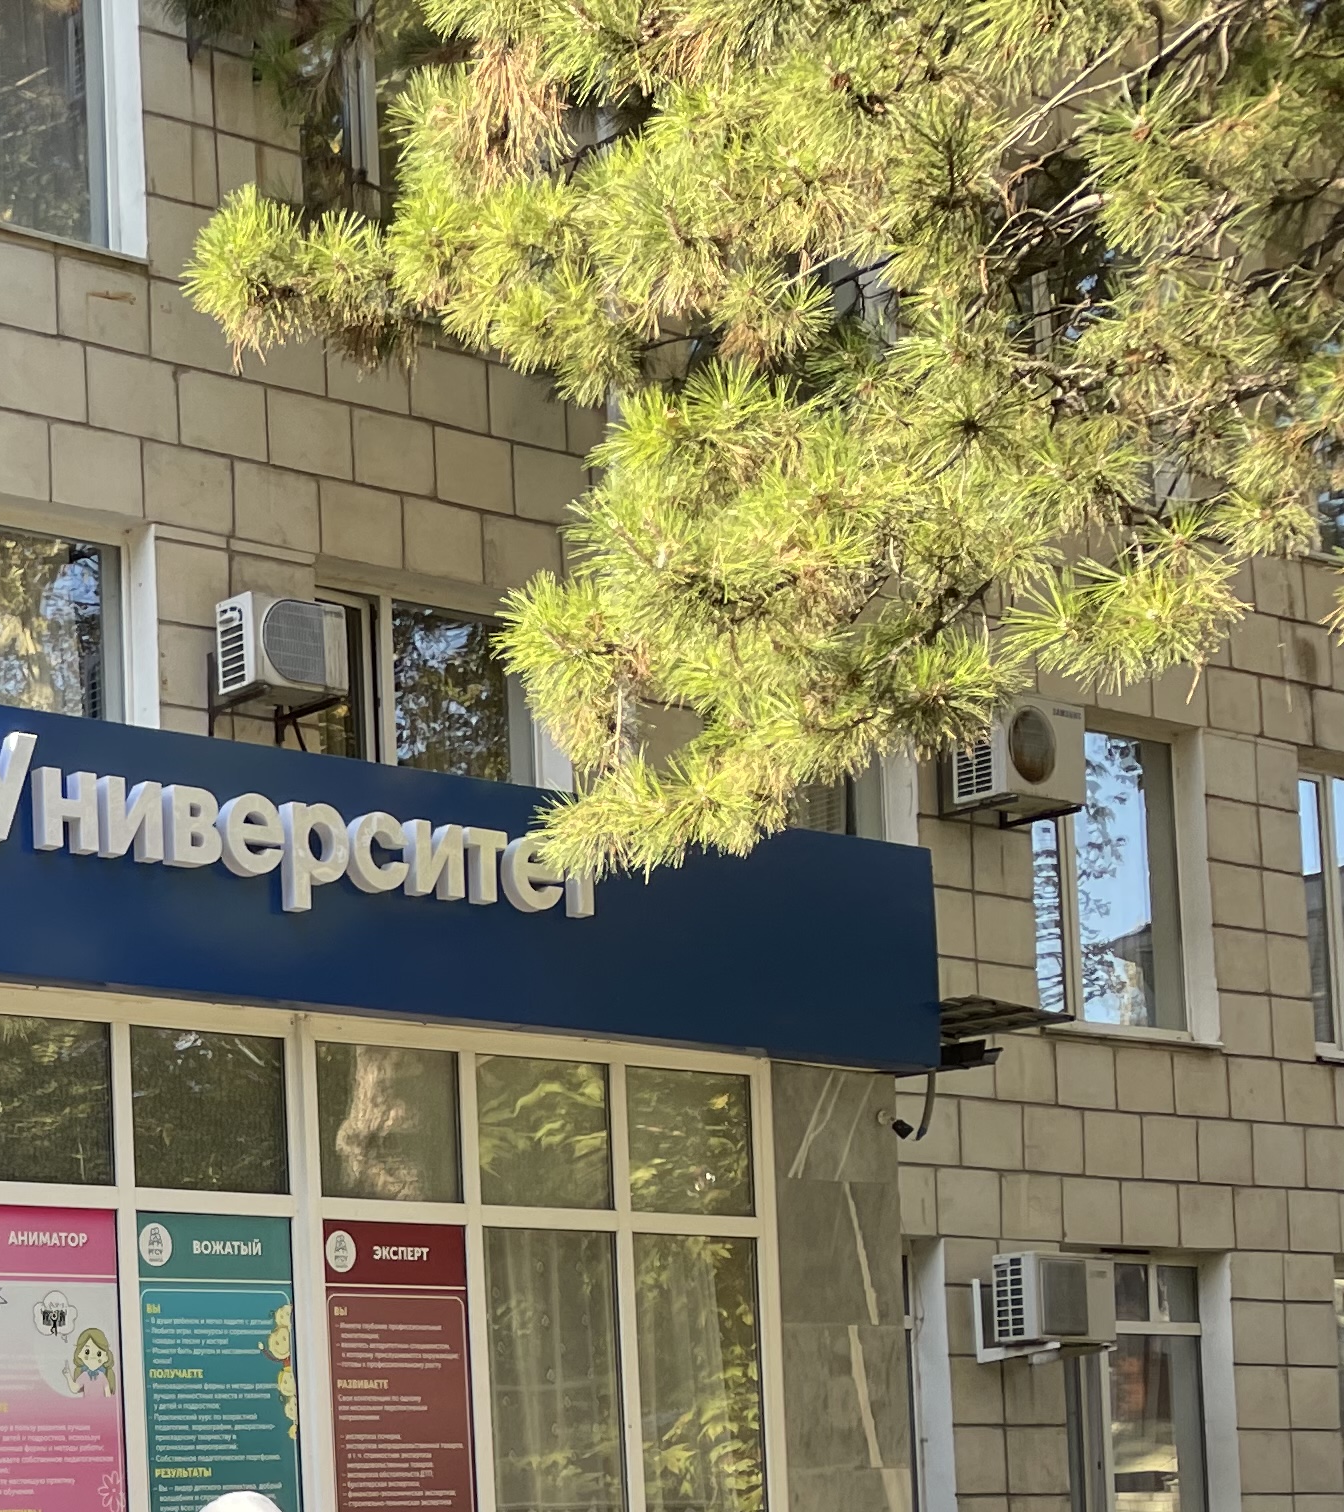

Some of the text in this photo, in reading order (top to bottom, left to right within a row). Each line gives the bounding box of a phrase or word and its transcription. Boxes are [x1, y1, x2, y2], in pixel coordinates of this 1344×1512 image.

[8, 1231, 88, 1248] АНИМАТОР
[192, 1239, 262, 1256] ВОЖАТЫЙ
[372, 1246, 430, 1261] ЭКСПЕРТ
[146, 1303, 161, 1314] ВЫ
[149, 1368, 204, 1379] ПОЛУЧАЕТЕ
[337, 1379, 389, 1390] РАЗВИВАЕТЕ
[155, 1467, 212, 1478] РЕЗУЛЬТАТЫ
